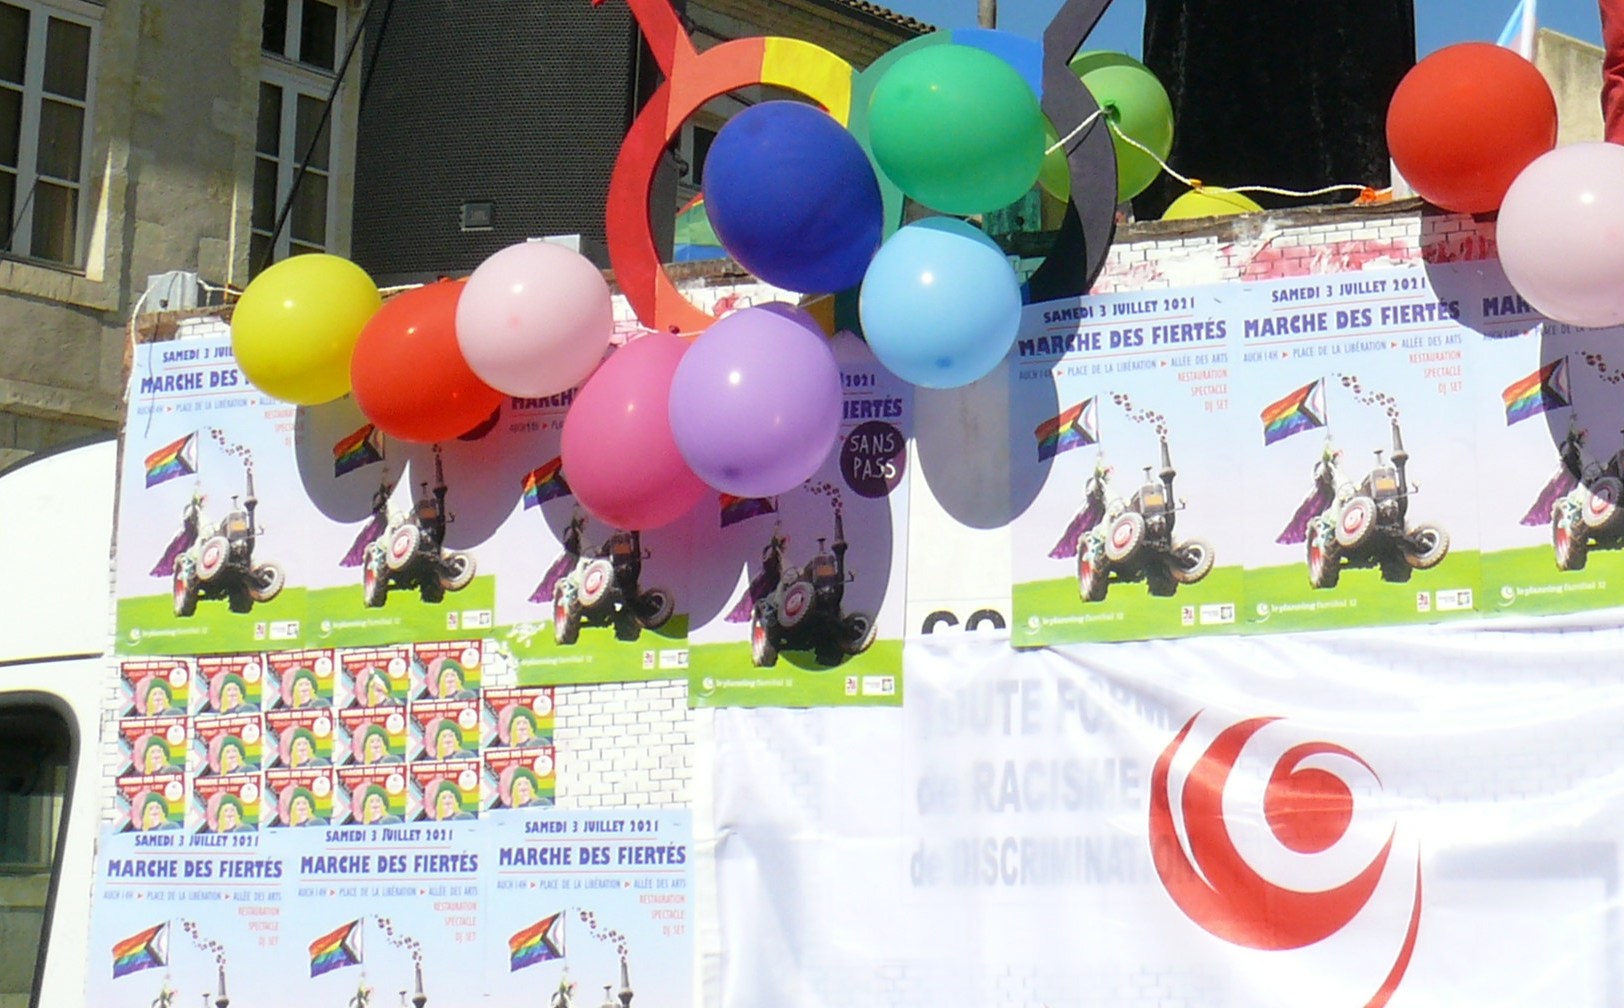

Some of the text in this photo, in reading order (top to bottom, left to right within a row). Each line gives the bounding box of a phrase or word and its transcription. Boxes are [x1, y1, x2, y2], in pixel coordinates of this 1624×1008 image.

[1272, 277, 1426, 303] SAMEDI 3 JUILLET 2021
[1043, 297, 1194, 323] SAMEDI 3 JUILLET 2021
[1244, 298, 1460, 338] MARCHE DES FIERTÉS
[1019, 317, 1226, 356] MARCHE DES FIERTÉS
[1293, 348, 1313, 358] PLACE
[1318, 346, 1327, 356] DE
[1332, 345, 1341, 355] LA
[1345, 341, 1386, 354] LIBÉRATION
[1402, 338, 1423, 348] ALLÉE
[1428, 336, 1442, 346] DES
[1445, 335, 1462, 344] ARTS
[163, 347, 233, 363] SAMEDI 3 JUIL
[1068, 354, 1228, 376] PLACE DE LA LIBÉRATION ALLÉE DES ARTS
[1409, 351, 1461, 363] RESTAURATION
[140, 369, 238, 393] MARCHE DES
[846, 373, 875, 387] 2021
[1424, 366, 1461, 378] SPECTACLE
[843, 395, 902, 419] IERTÉS
[850, 433, 894, 455] SANS
[854, 457, 896, 480] PASS
[326, 828, 452, 842] SAMEDI 3 JUILLET 2021
[525, 820, 658, 833] SAMEDI 3 JUILLET 2021
[135, 835, 259, 847] SAMEDI 3 JUILLET 2021
[301, 850, 478, 873] MARCHE DES FIERTÉS
[499, 842, 686, 865] MARCHE DES FIERTÉS
[108, 856, 282, 878] MARCHE DES FIERTÉS
